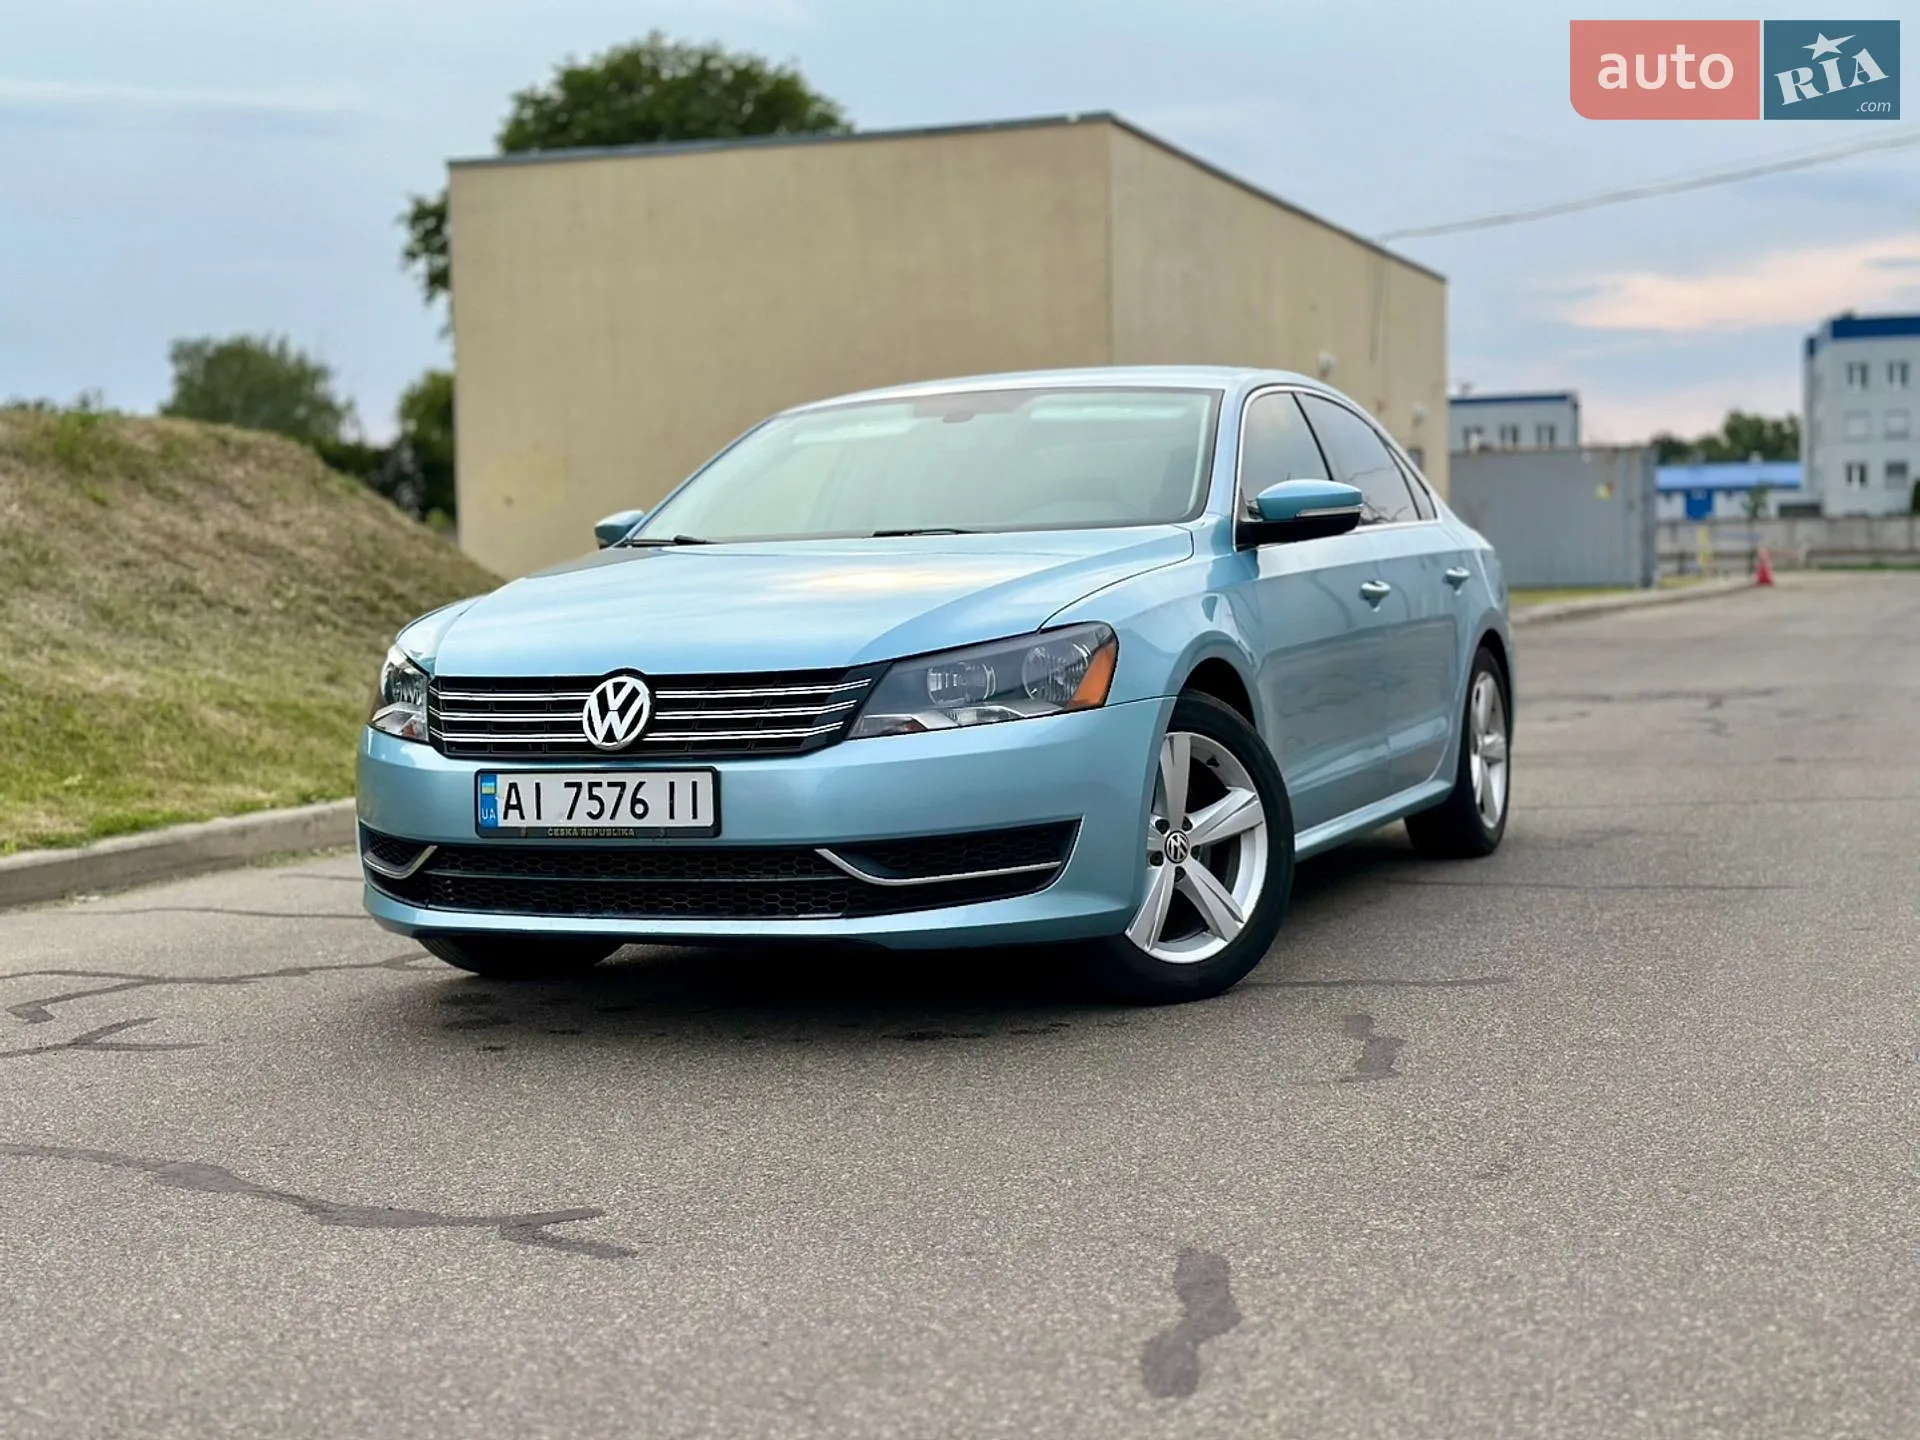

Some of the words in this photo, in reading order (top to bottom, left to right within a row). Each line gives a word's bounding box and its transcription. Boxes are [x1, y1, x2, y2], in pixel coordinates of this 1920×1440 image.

[585, 678, 646, 745] VW
[481, 807, 496, 820] UA
[502, 782, 542, 820] AI
[563, 781, 649, 820] 7576
[581, 828, 635, 836] REPUBLIKA
